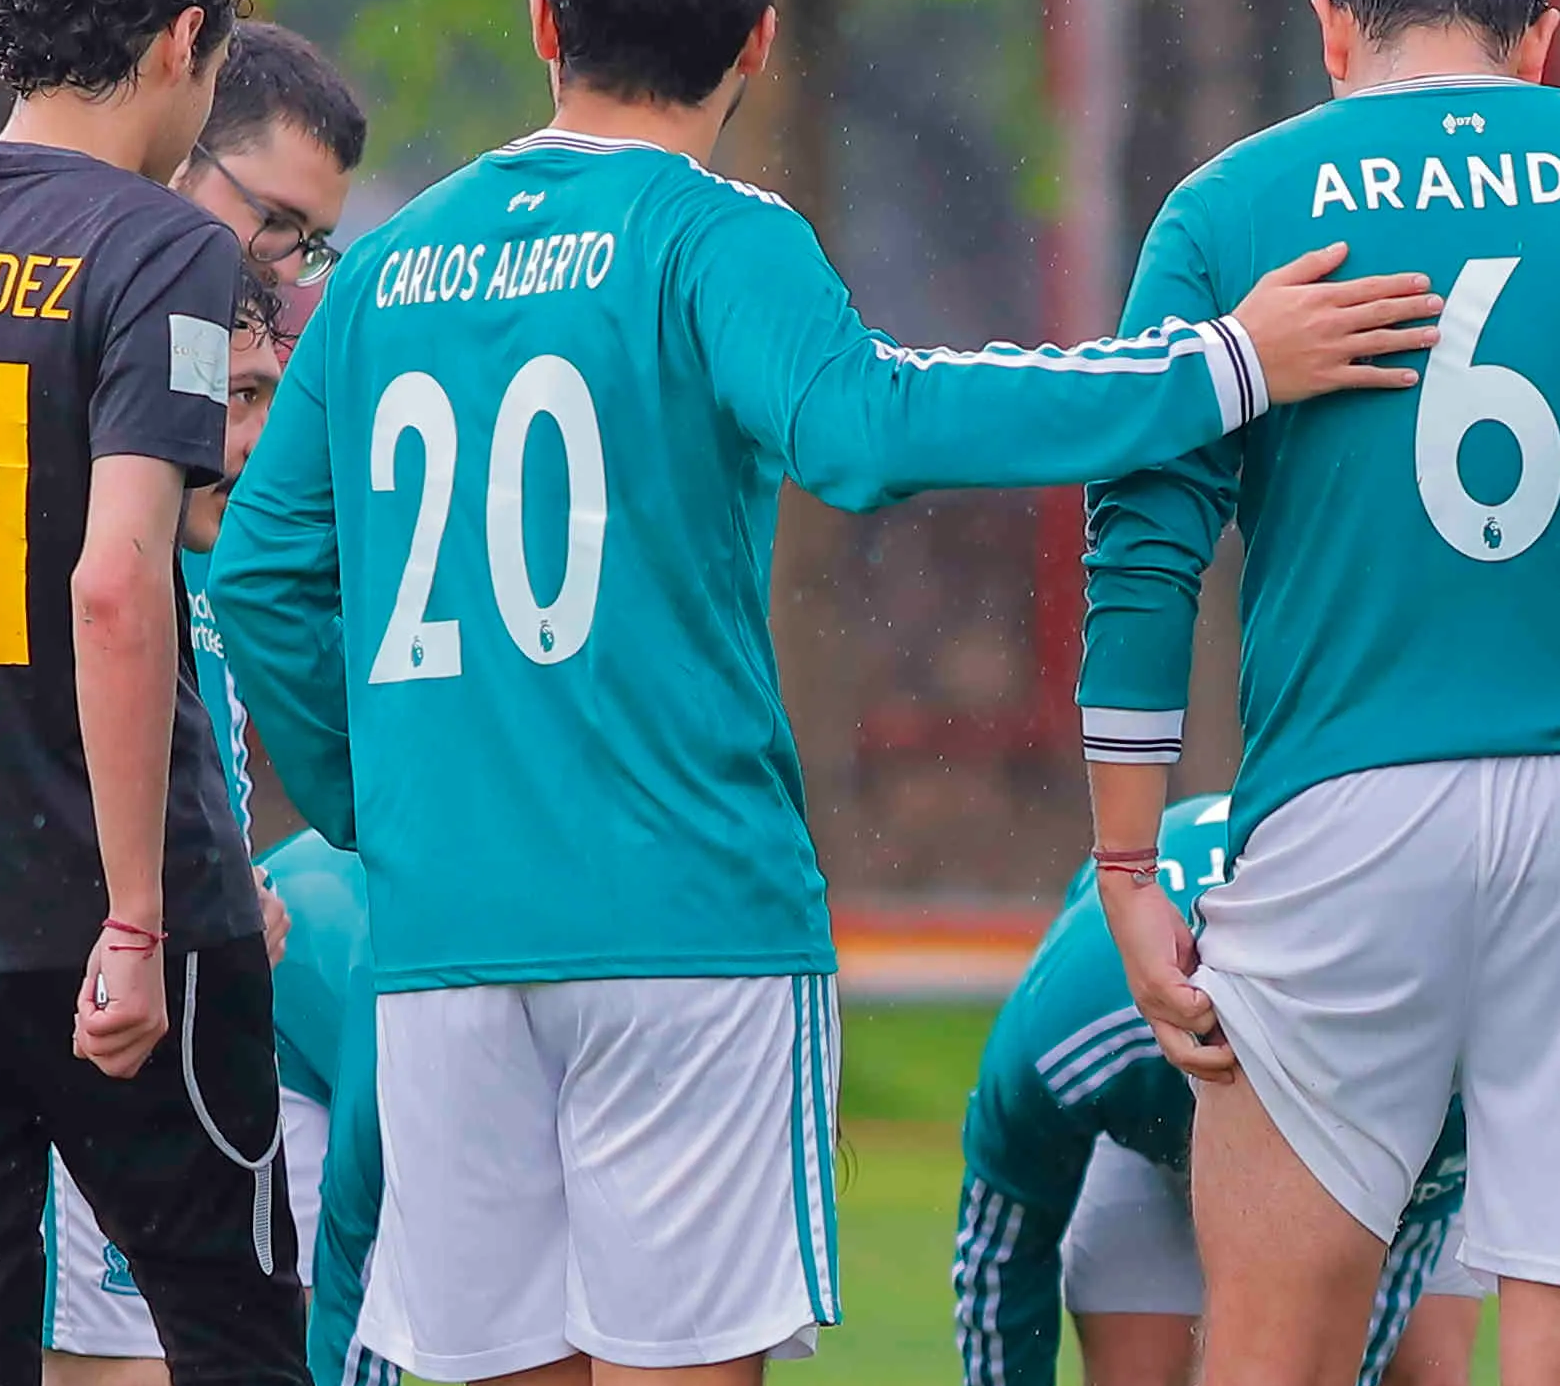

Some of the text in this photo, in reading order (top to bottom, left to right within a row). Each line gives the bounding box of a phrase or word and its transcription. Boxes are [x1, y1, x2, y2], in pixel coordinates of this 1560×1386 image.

[376, 231, 615, 308] CARLOS ALBERTO
[368, 354, 607, 684] 20
